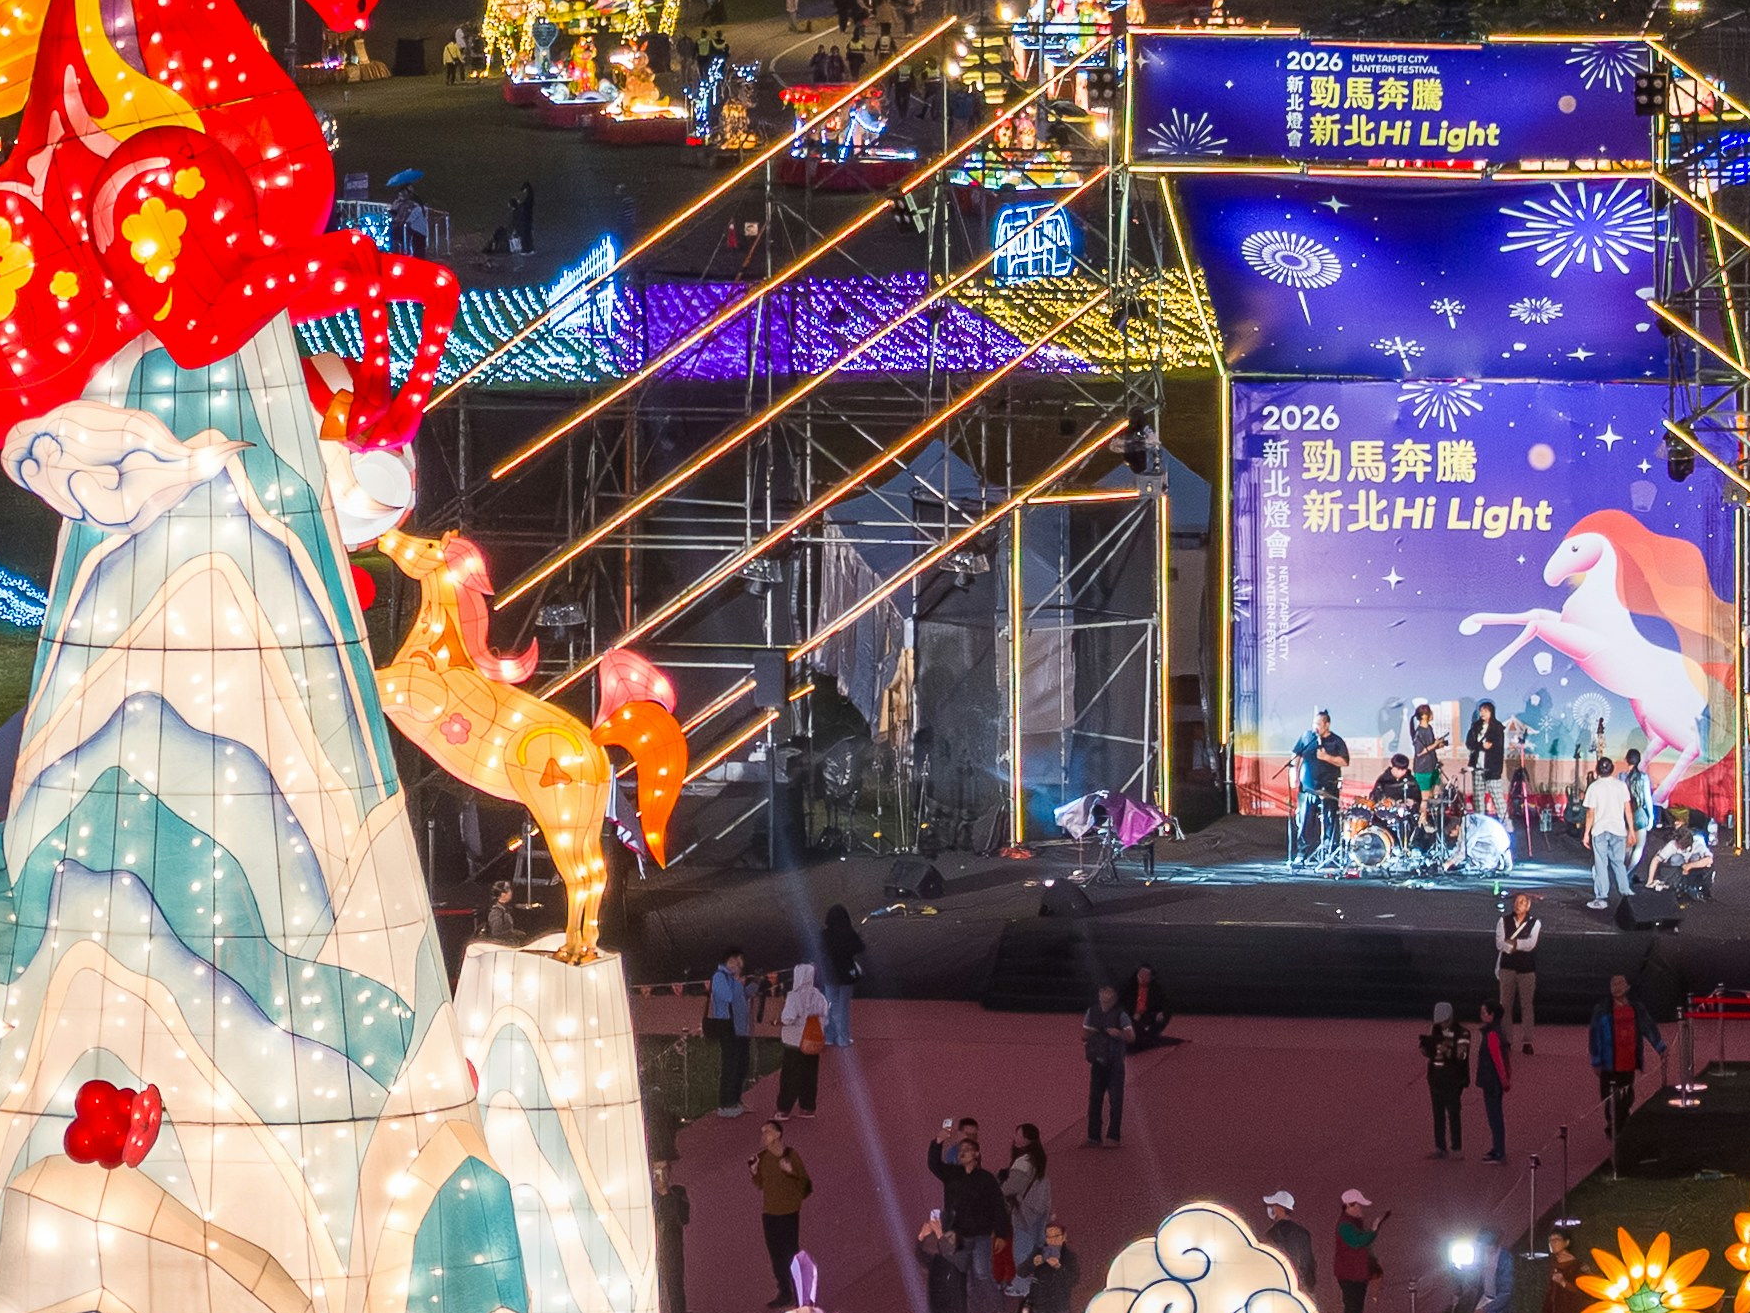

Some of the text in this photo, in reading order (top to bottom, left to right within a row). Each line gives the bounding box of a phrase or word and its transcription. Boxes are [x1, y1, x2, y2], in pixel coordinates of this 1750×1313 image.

[1286, 51, 1343, 71] 2026
[1352, 54, 1429, 64] NEW TAIPEI CITY
[1352, 64, 1440, 75] LANTERN FESTIVAL
[1286, 75, 1304, 148] 新北燈會
[1309, 75, 1443, 112] 勁馬奔騰
[1420, 121, 1501, 153] Light
[1261, 405, 1340, 431] 2026
[1301, 439, 1478, 483] 勁馬奔騰
[1263, 439, 1291, 559] 新北燈會
[1447, 496, 1553, 539] Light
[1266, 565, 1276, 675] LANTERN FESTIVAL
[1279, 565, 1289, 661] NEW TAIPEI CITY
